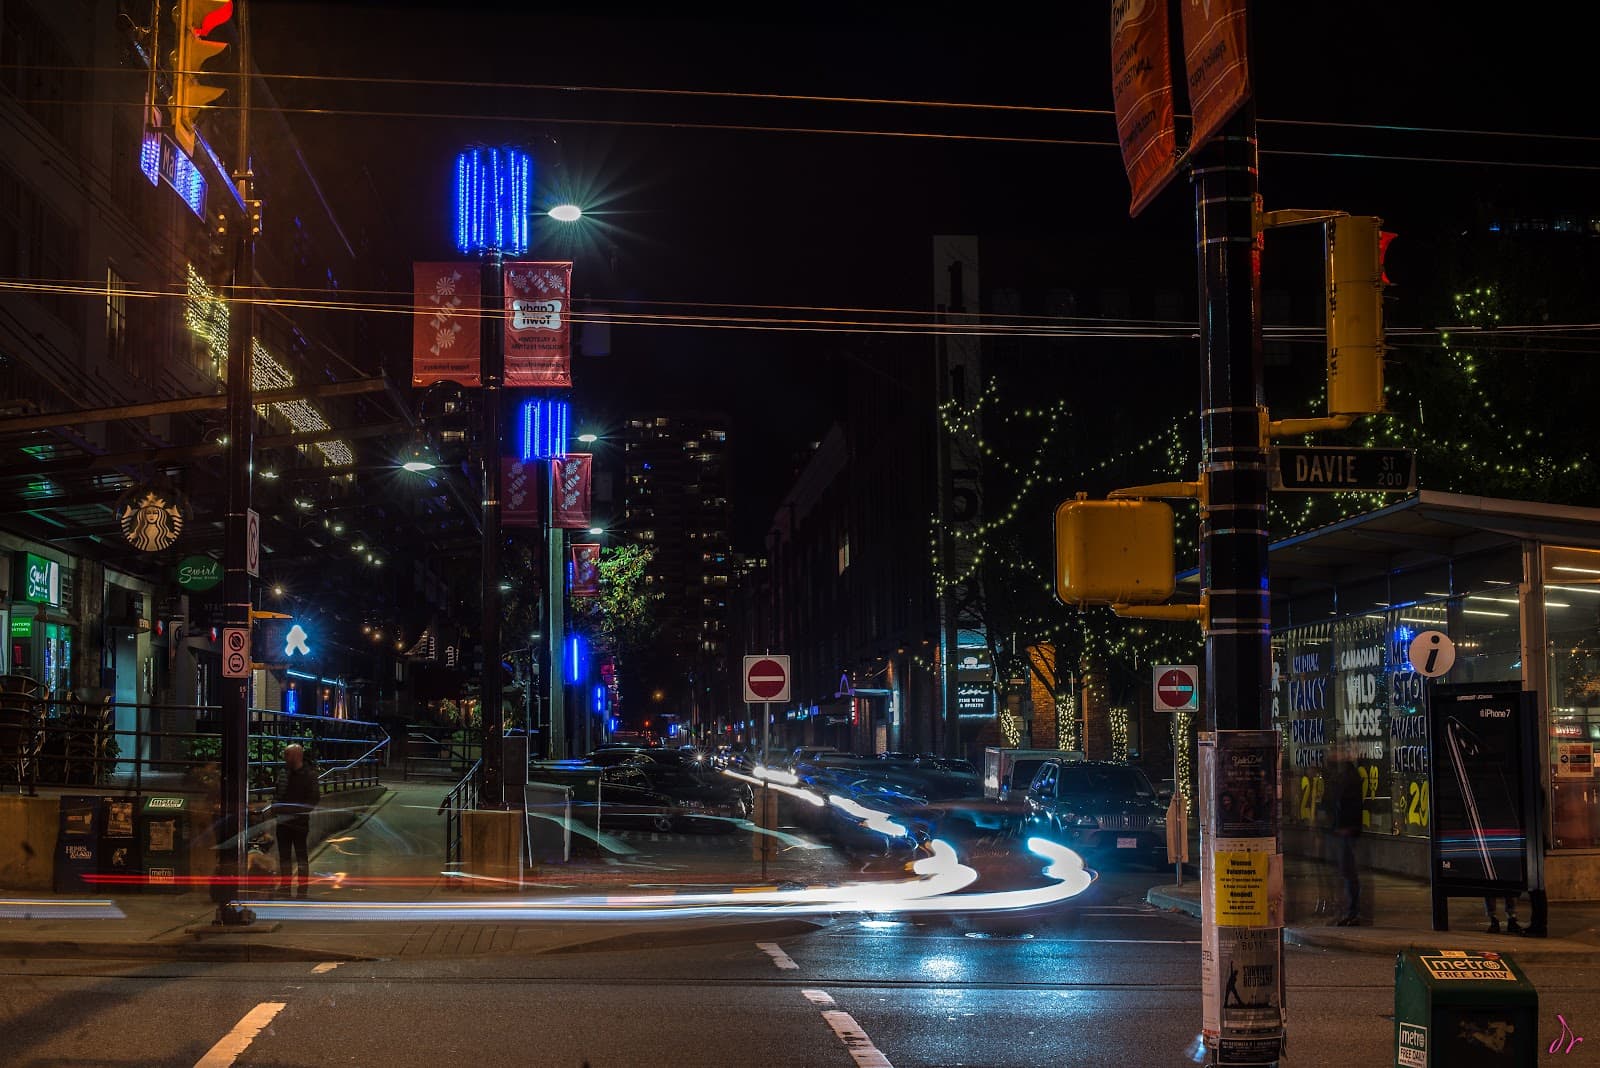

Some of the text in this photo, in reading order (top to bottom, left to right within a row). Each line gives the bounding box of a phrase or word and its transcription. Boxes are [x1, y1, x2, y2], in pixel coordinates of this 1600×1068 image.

[1296, 455, 1360, 483] DAVIE
[1377, 472, 1404, 487] 200
[1341, 646, 1380, 671] CANADIAN
[1287, 678, 1327, 713] FANCY
[1346, 673, 1376, 705] WILD
[1343, 708, 1383, 736] MOOSE
[1431, 958, 1500, 971] metro
[1437, 971, 1508, 980] FREE DAILY
[1401, 1029, 1426, 1049] metro
[1400, 1048, 1426, 1061] FREE DAILY
